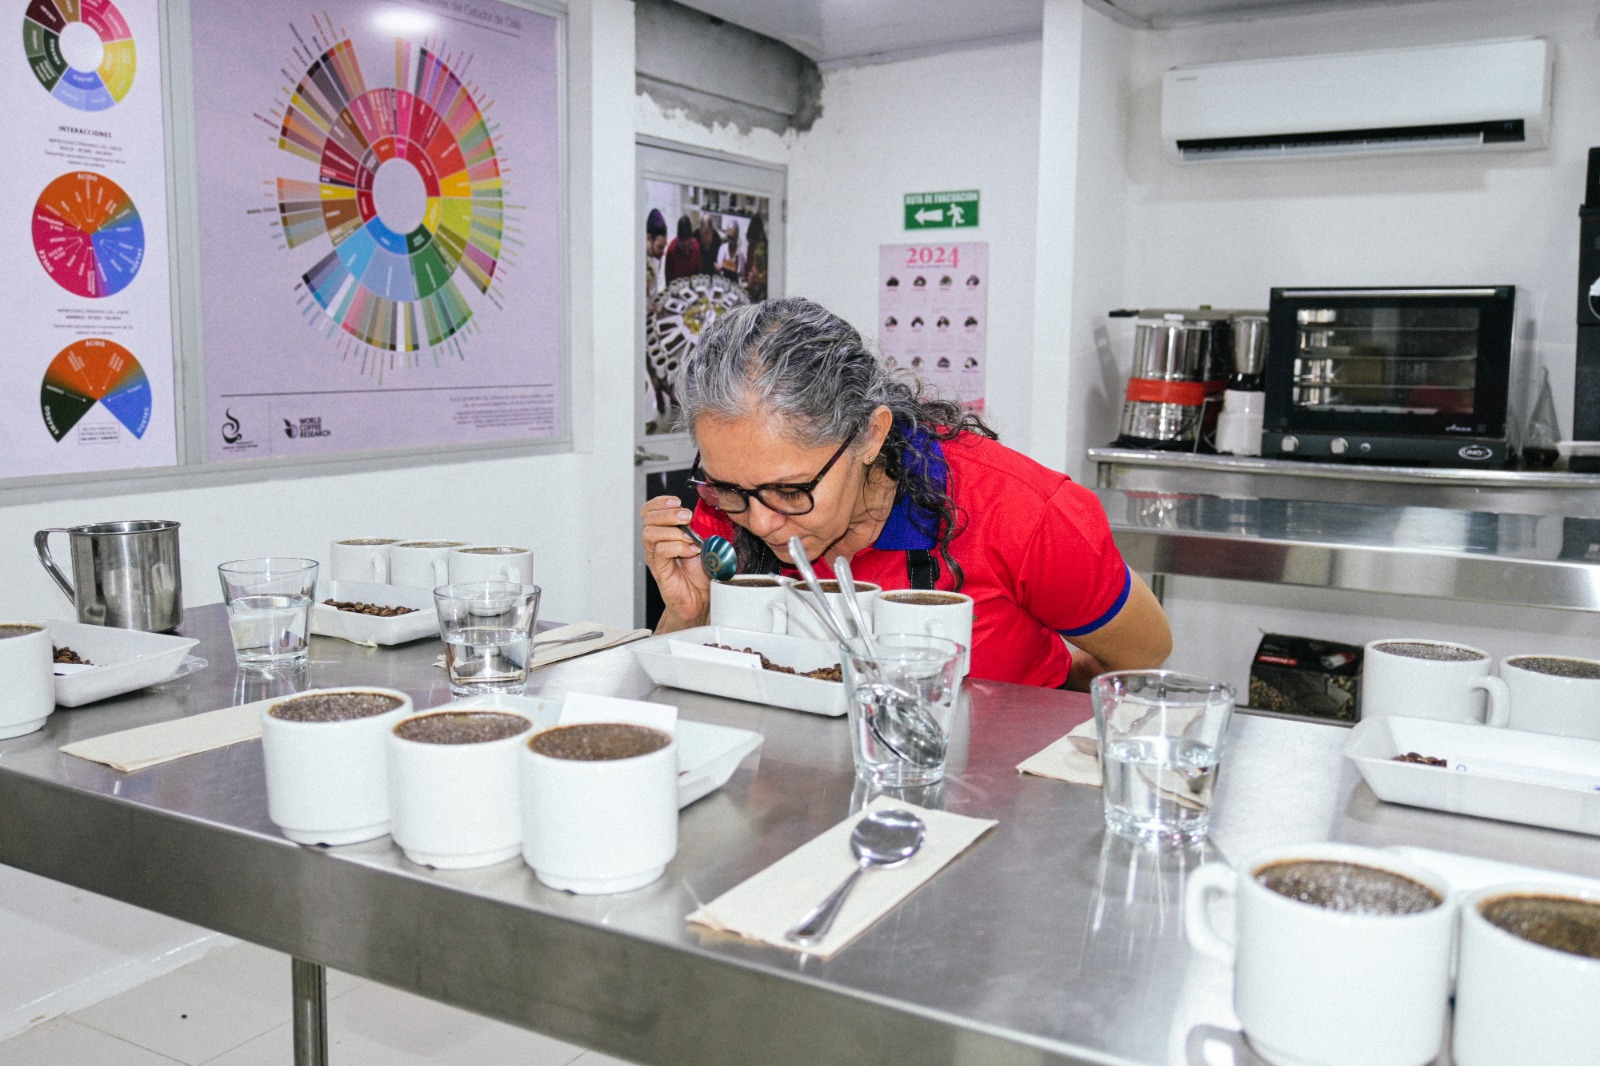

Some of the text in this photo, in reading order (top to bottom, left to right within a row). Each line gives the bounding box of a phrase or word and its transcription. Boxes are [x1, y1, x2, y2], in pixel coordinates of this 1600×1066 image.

[58, 125, 112, 138] INTERACCIONES
[906, 246, 960, 269] 2024
[299, 416, 322, 424] WORLD
[299, 423, 322, 431] COFFEE
[299, 430, 332, 438] RESEARCH
